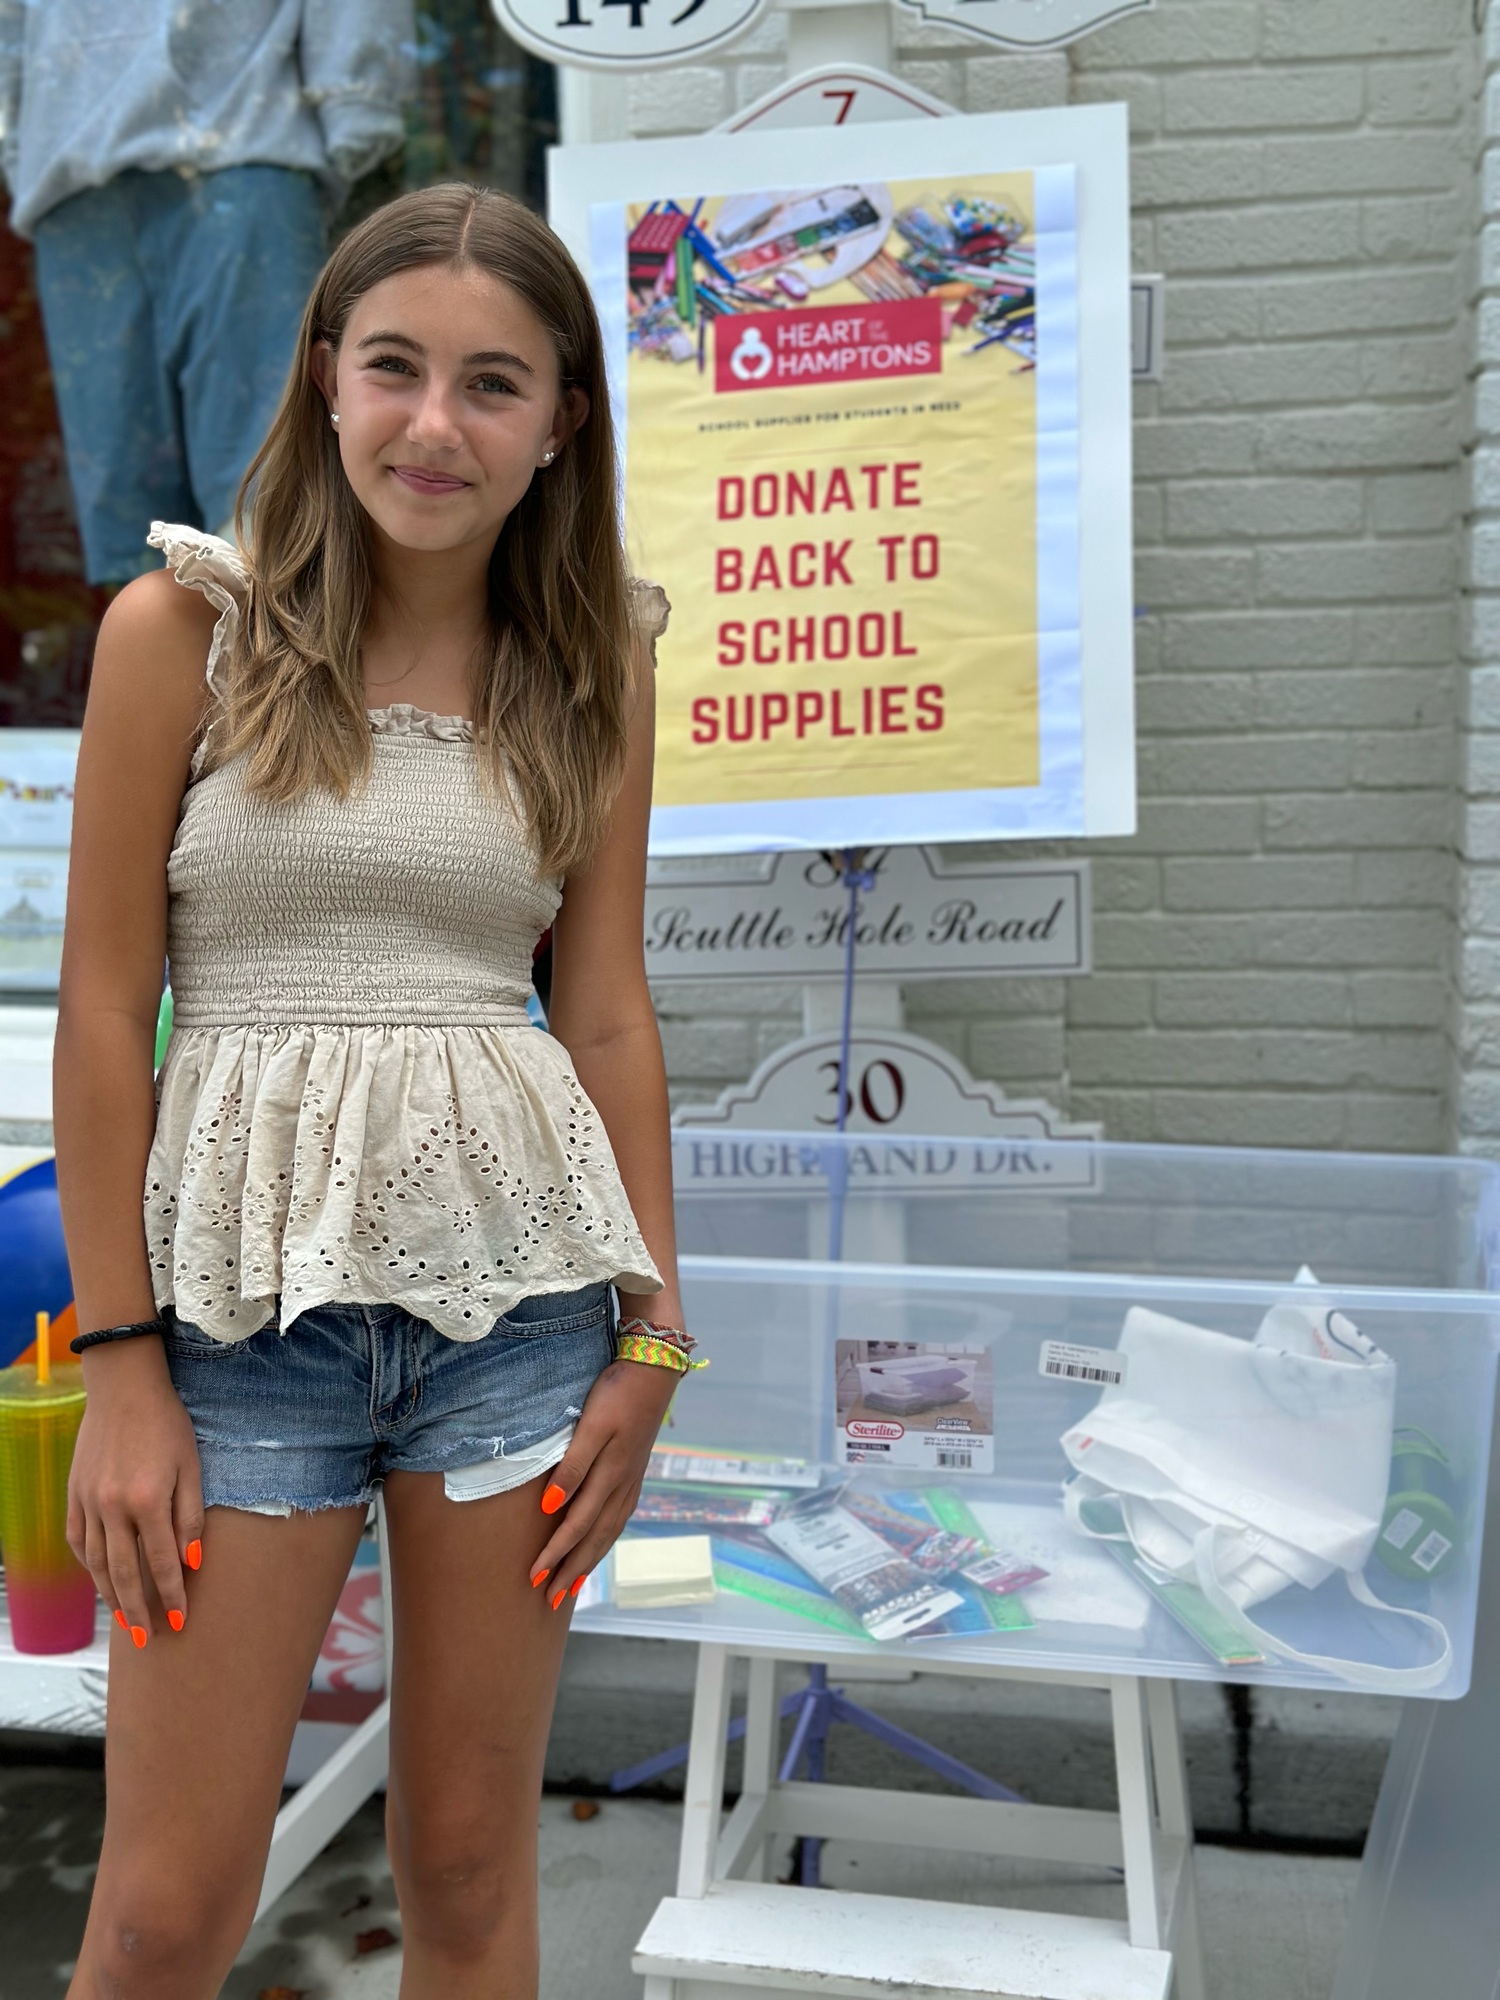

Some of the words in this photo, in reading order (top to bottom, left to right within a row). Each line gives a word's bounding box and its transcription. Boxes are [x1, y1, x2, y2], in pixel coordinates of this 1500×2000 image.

[777, 319, 864, 349] HEART
[777, 341, 932, 377] HAMPTONS
[698, 421, 750, 434] SCHOOL
[754, 414, 811, 429] SUPPLIES
[816, 411, 840, 424] FOR
[844, 406, 908, 421] STUDENTS
[912, 404, 925, 414] IN
[929, 401, 961, 412] NEED
[717, 462, 923, 521] DONATE
[715, 539, 854, 594] BACK
[878, 534, 940, 582] TO
[717, 610, 918, 667] SCHOOL
[691, 684, 945, 745] SUPPLIES
[646, 905, 796, 953] Scuttle
[805, 900, 915, 948] Hole
[927, 899, 1065, 945] Road
[813, 1058, 907, 1125] 30
[689, 1140, 958, 1179] HIGHAND
[972, 1134, 1053, 1174] DR.
[852, 1423, 898, 1437] Sterilite
